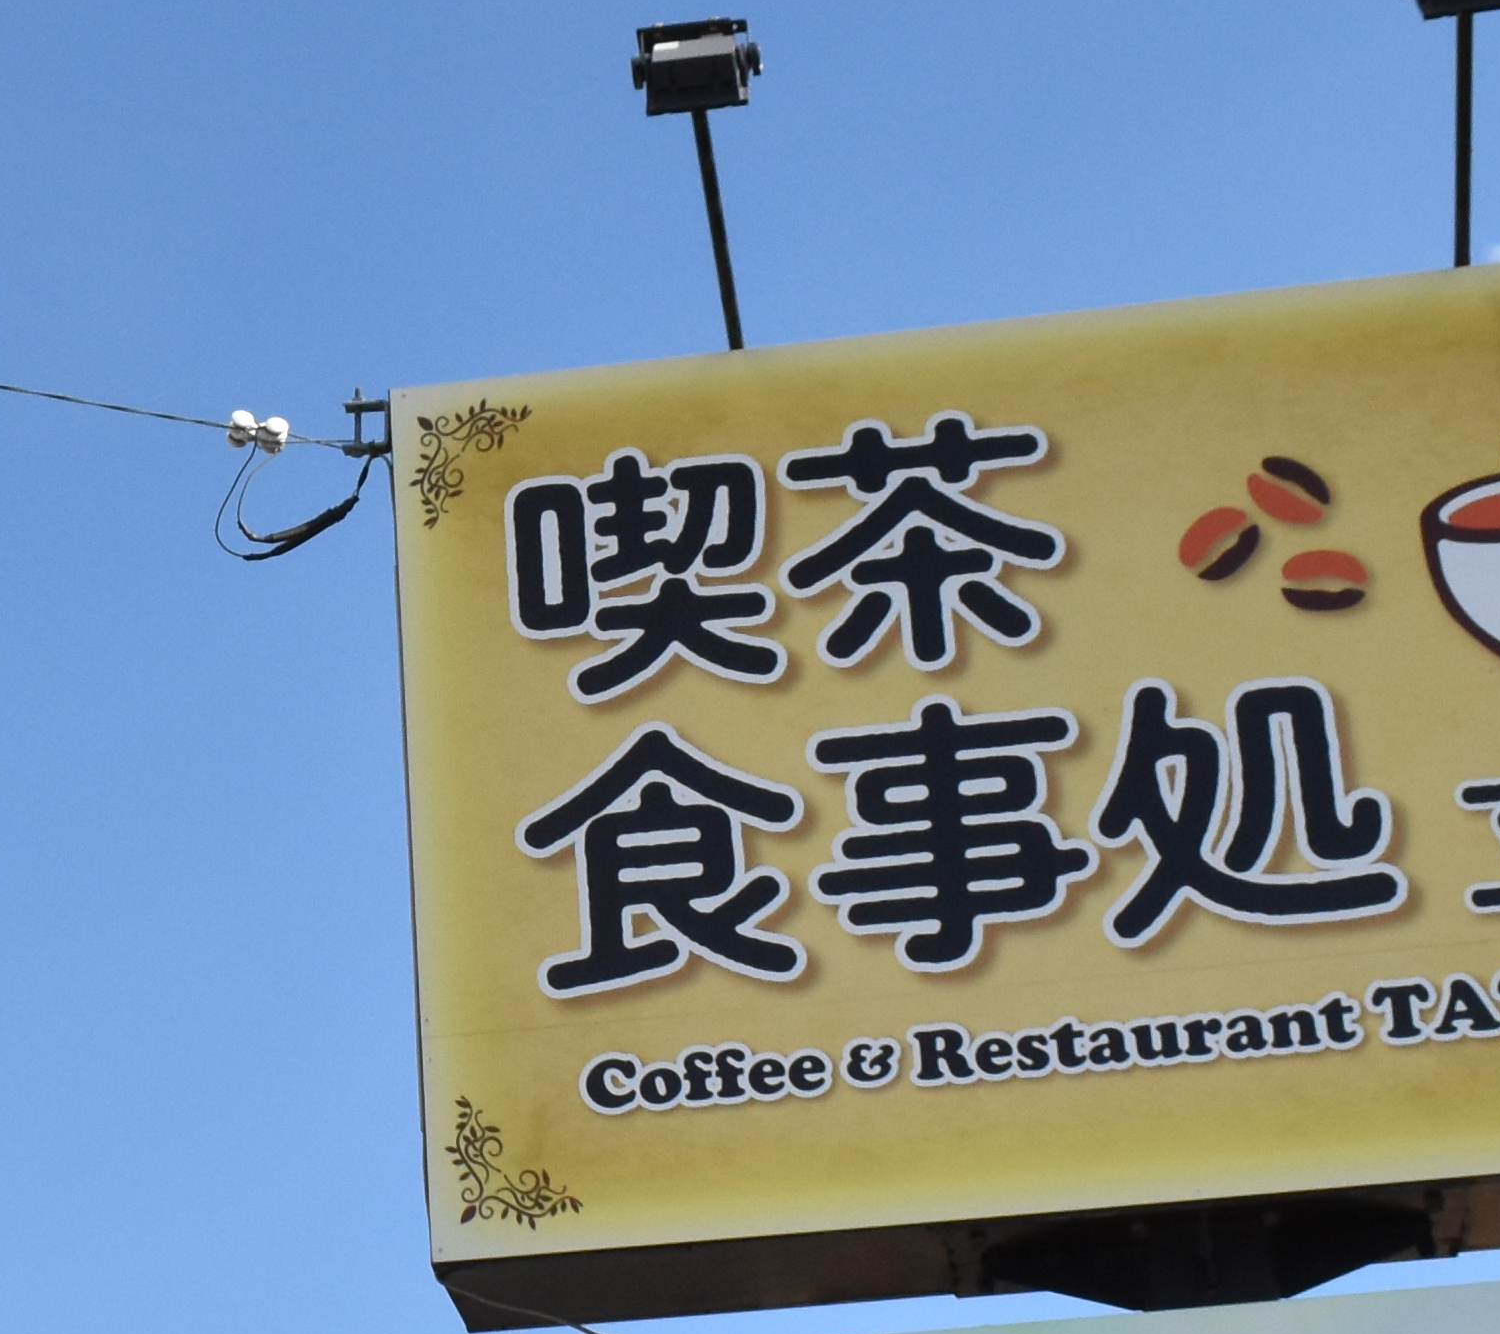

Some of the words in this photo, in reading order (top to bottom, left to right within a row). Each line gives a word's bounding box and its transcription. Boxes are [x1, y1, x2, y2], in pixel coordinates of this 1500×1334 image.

[508, 412, 1060, 701] 喫茶
[518, 680, 1403, 995] 食事処
[583, 1041, 829, 1112] Coffee
[845, 1041, 896, 1085] &
[911, 996, 1360, 1085] Restaurant
